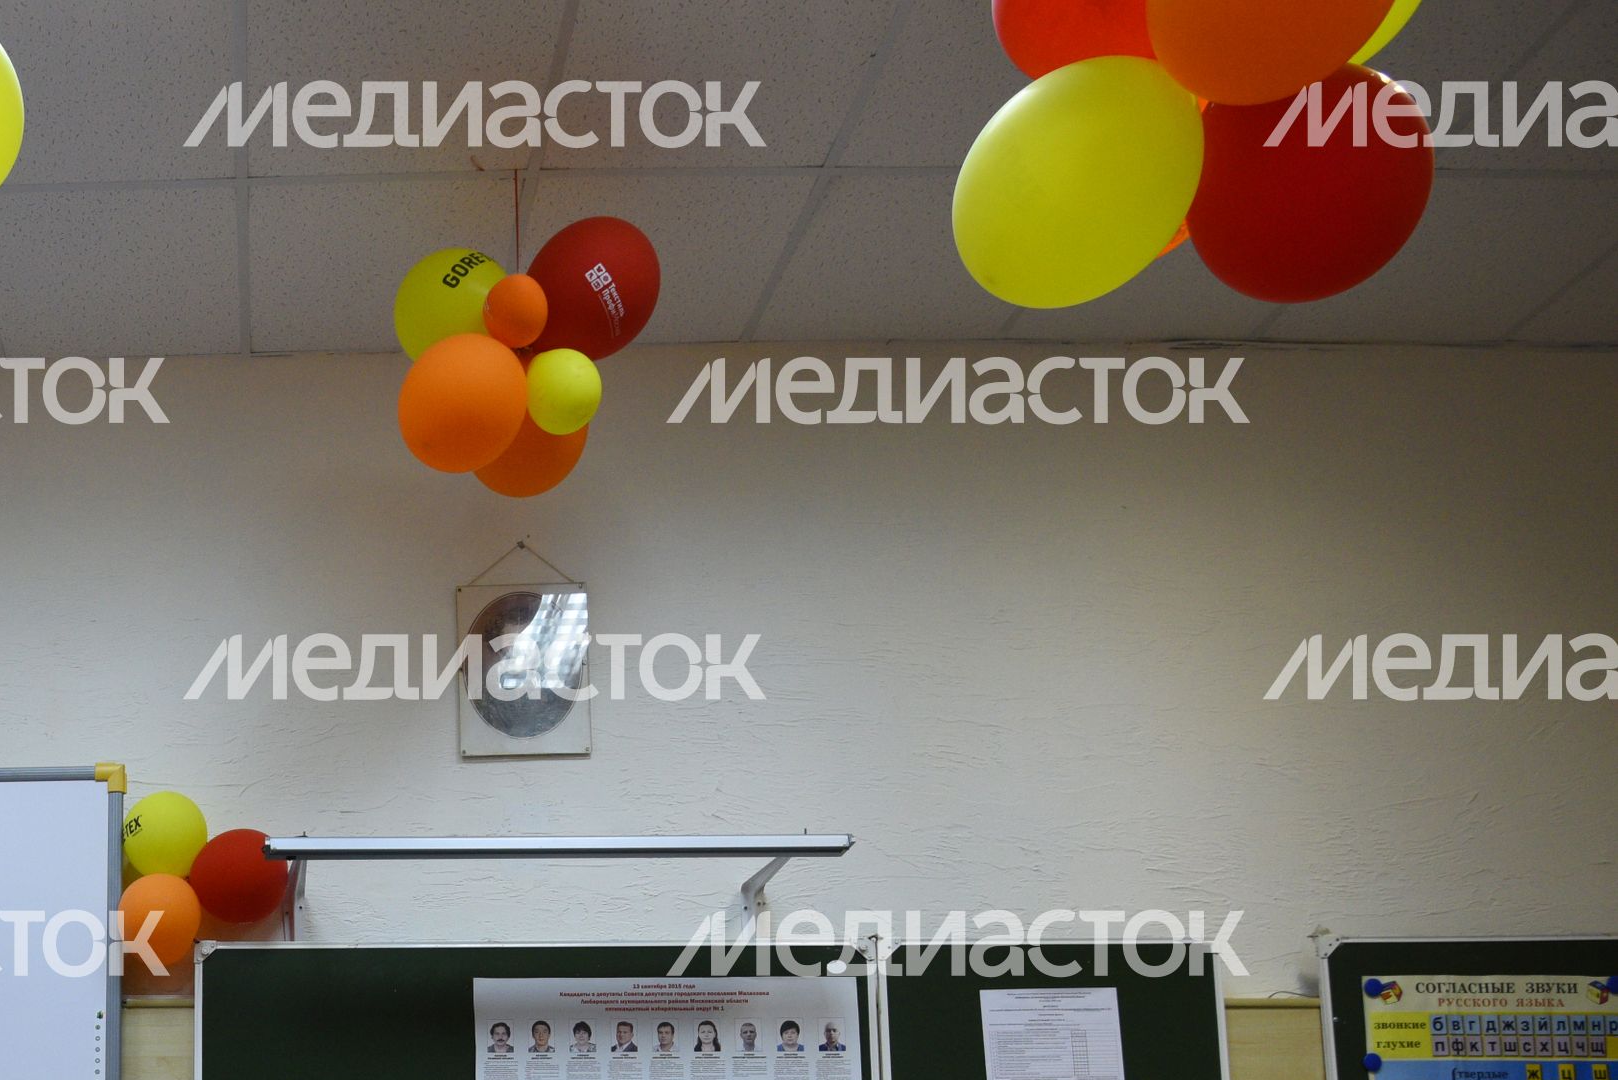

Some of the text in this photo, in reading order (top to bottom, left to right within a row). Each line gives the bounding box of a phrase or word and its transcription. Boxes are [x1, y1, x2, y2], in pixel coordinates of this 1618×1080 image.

[1415, 982, 1578, 994] СОГЛАСНЫЕ ЗВУКИ
[1438, 998, 1565, 1008] РУССКОГО ЯЗЫКА
[1374, 1021, 1426, 1030] звонкие
[1376, 1041, 1421, 1050] глухие
[1457, 1071, 1509, 1080] твердые
